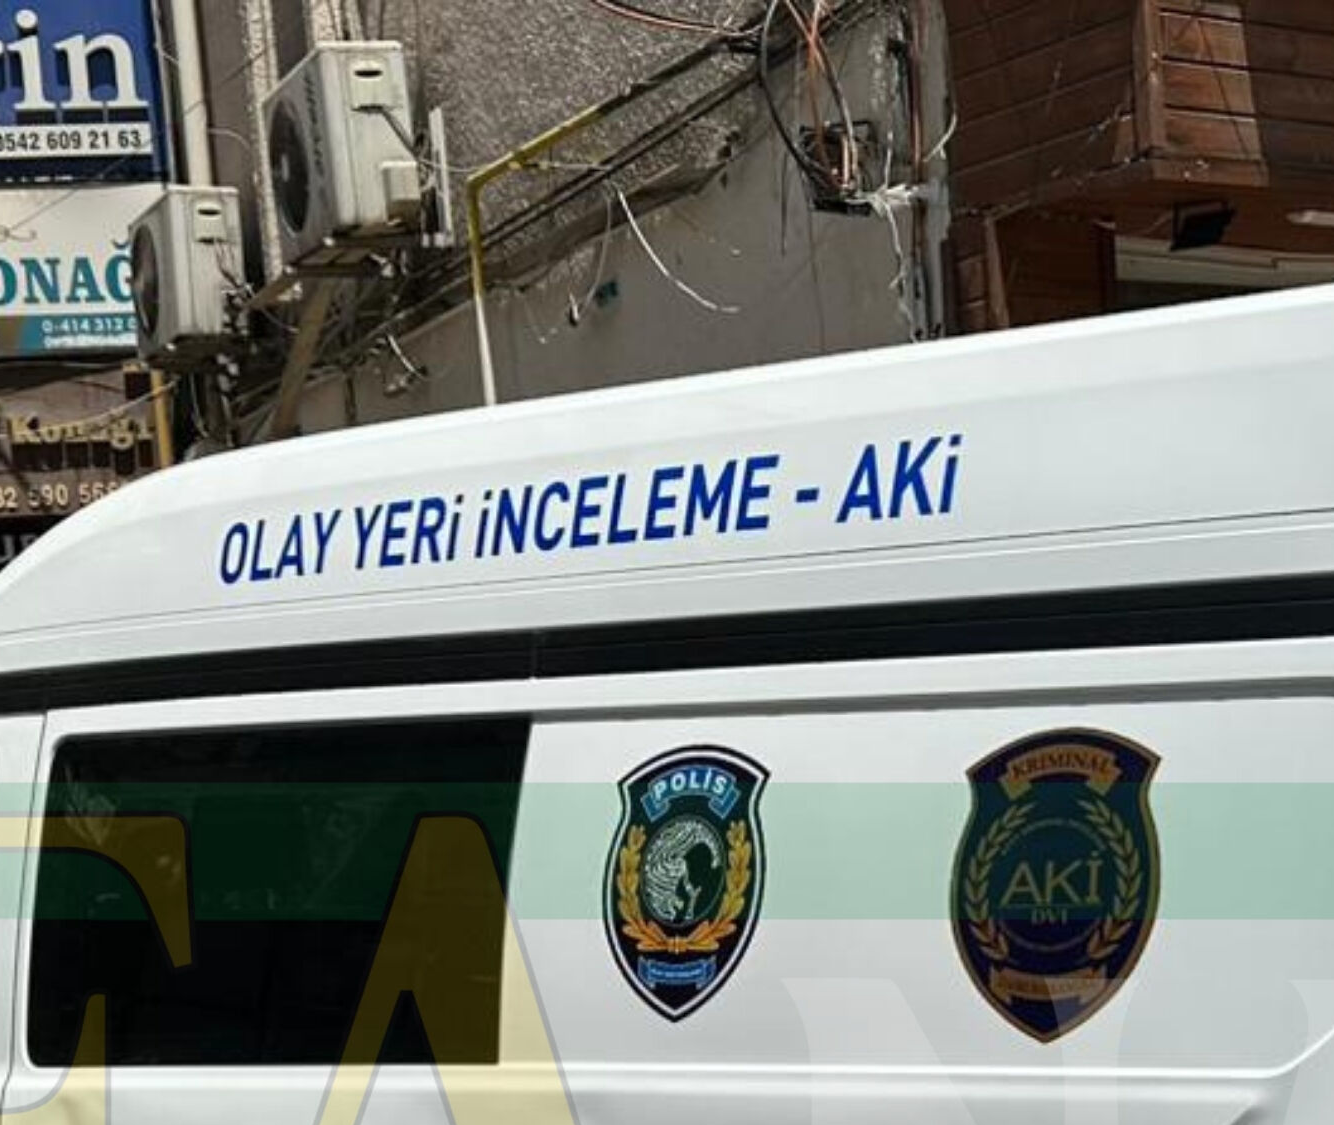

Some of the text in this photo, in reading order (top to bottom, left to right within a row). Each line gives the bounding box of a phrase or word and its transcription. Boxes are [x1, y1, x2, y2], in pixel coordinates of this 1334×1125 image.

[47, 131, 81, 150] 609
[90, 131, 110, 149] 21
[119, 130, 142, 148] 63
[219, 508, 341, 585] OLAY
[1000, 850, 1106, 907] AKİ
